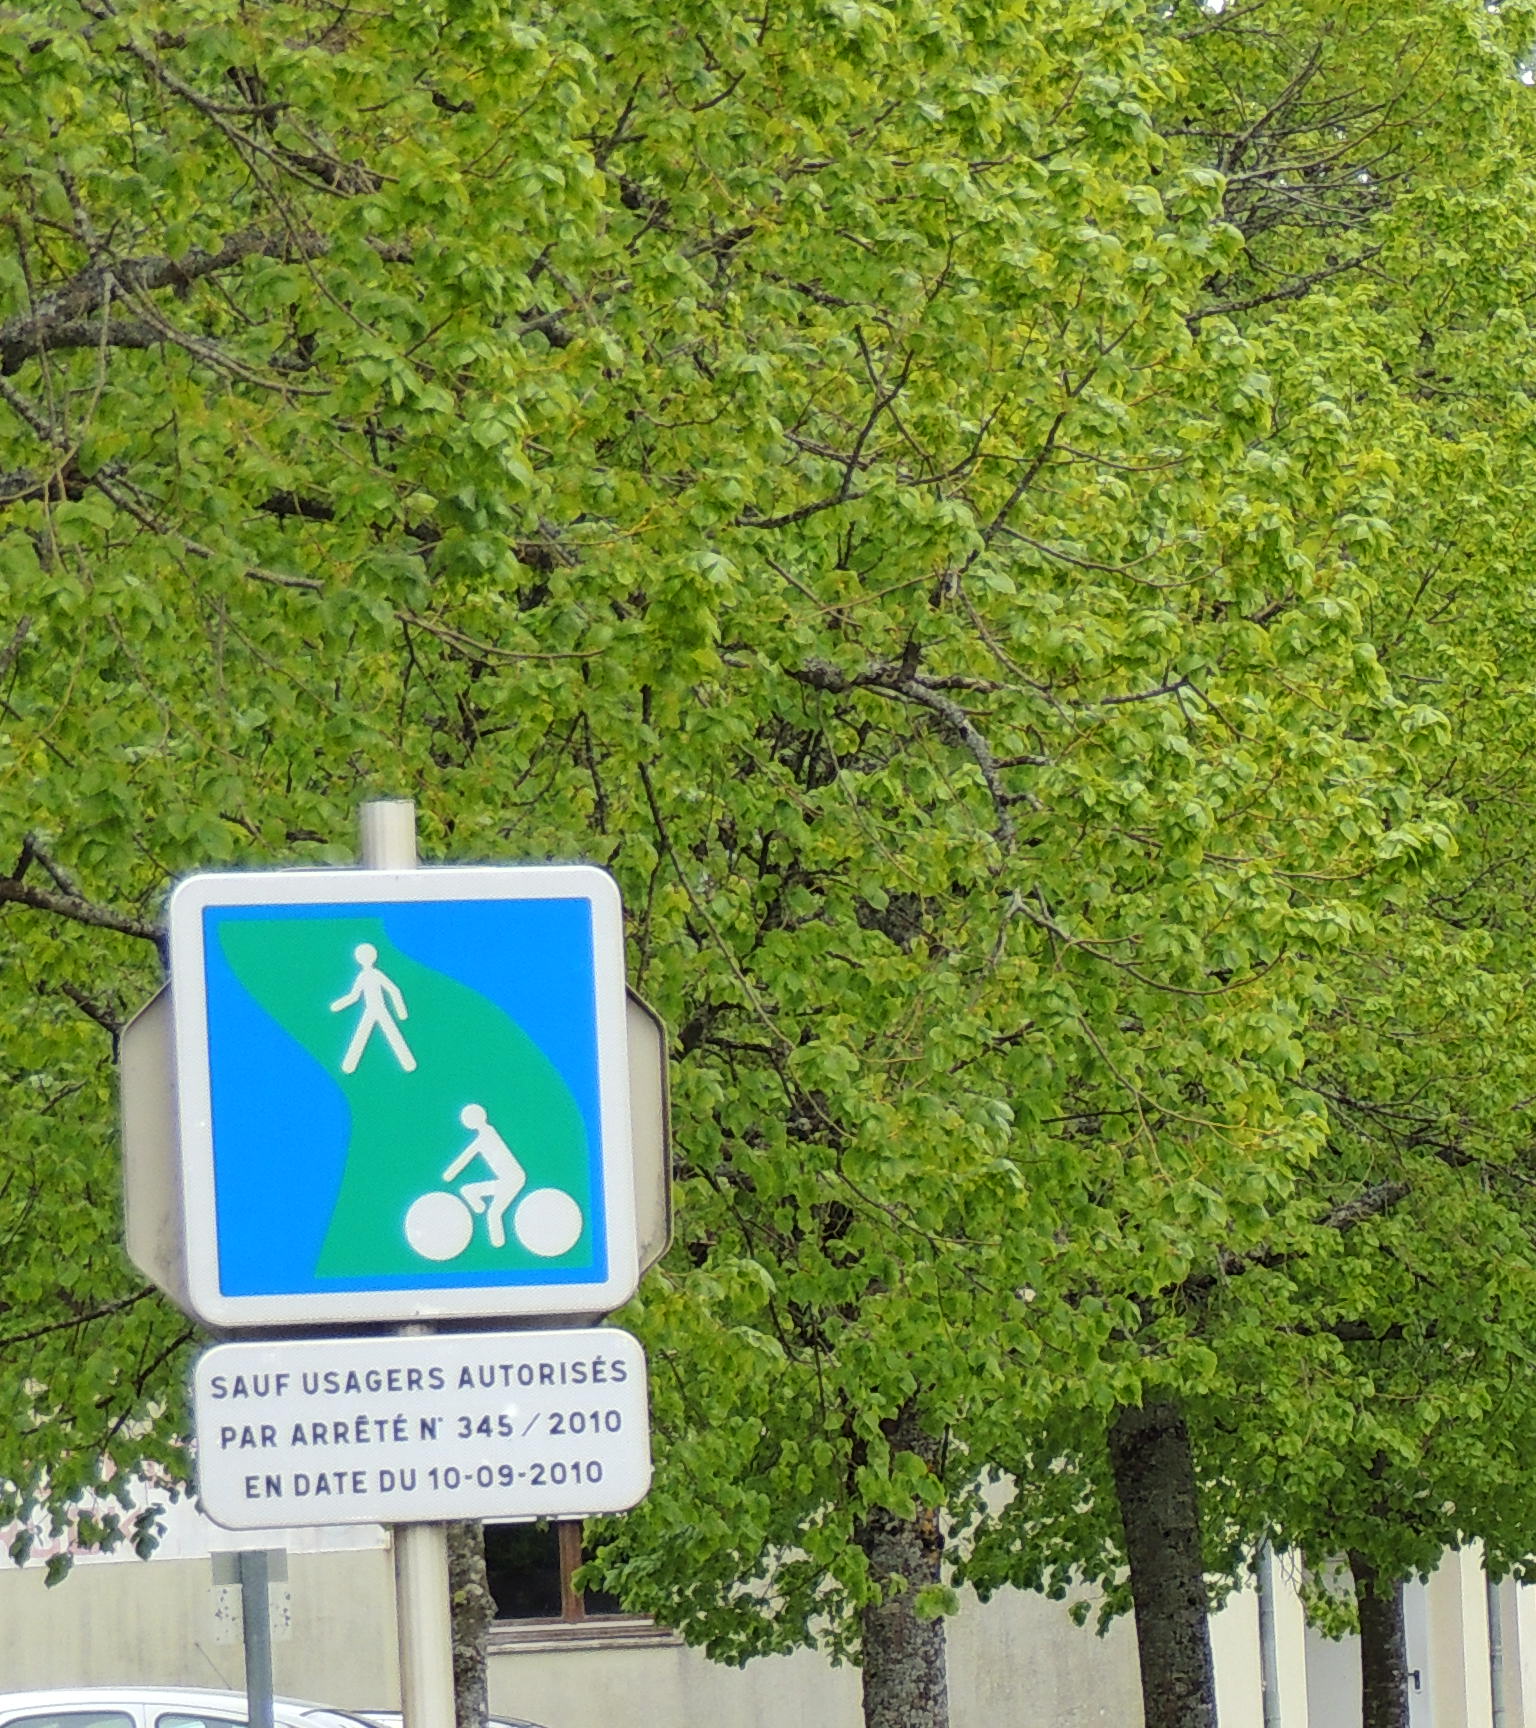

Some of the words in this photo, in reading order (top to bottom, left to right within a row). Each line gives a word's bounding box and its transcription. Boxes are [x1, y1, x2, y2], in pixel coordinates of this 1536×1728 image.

[210, 1373, 290, 1400] SAUF
[302, 1367, 445, 1396] USAGERS
[458, 1355, 628, 1389] AUTORISÉS
[220, 1424, 277, 1450] PAR
[290, 1413, 409, 1447] ARRÊTÉ
[457, 1414, 513, 1439] 345
[548, 1409, 622, 1435] 2010
[244, 1474, 283, 1499] EN
[293, 1470, 368, 1497] DATE
[379, 1468, 417, 1493] DU
[428, 1460, 603, 1490] 10-09-2010
